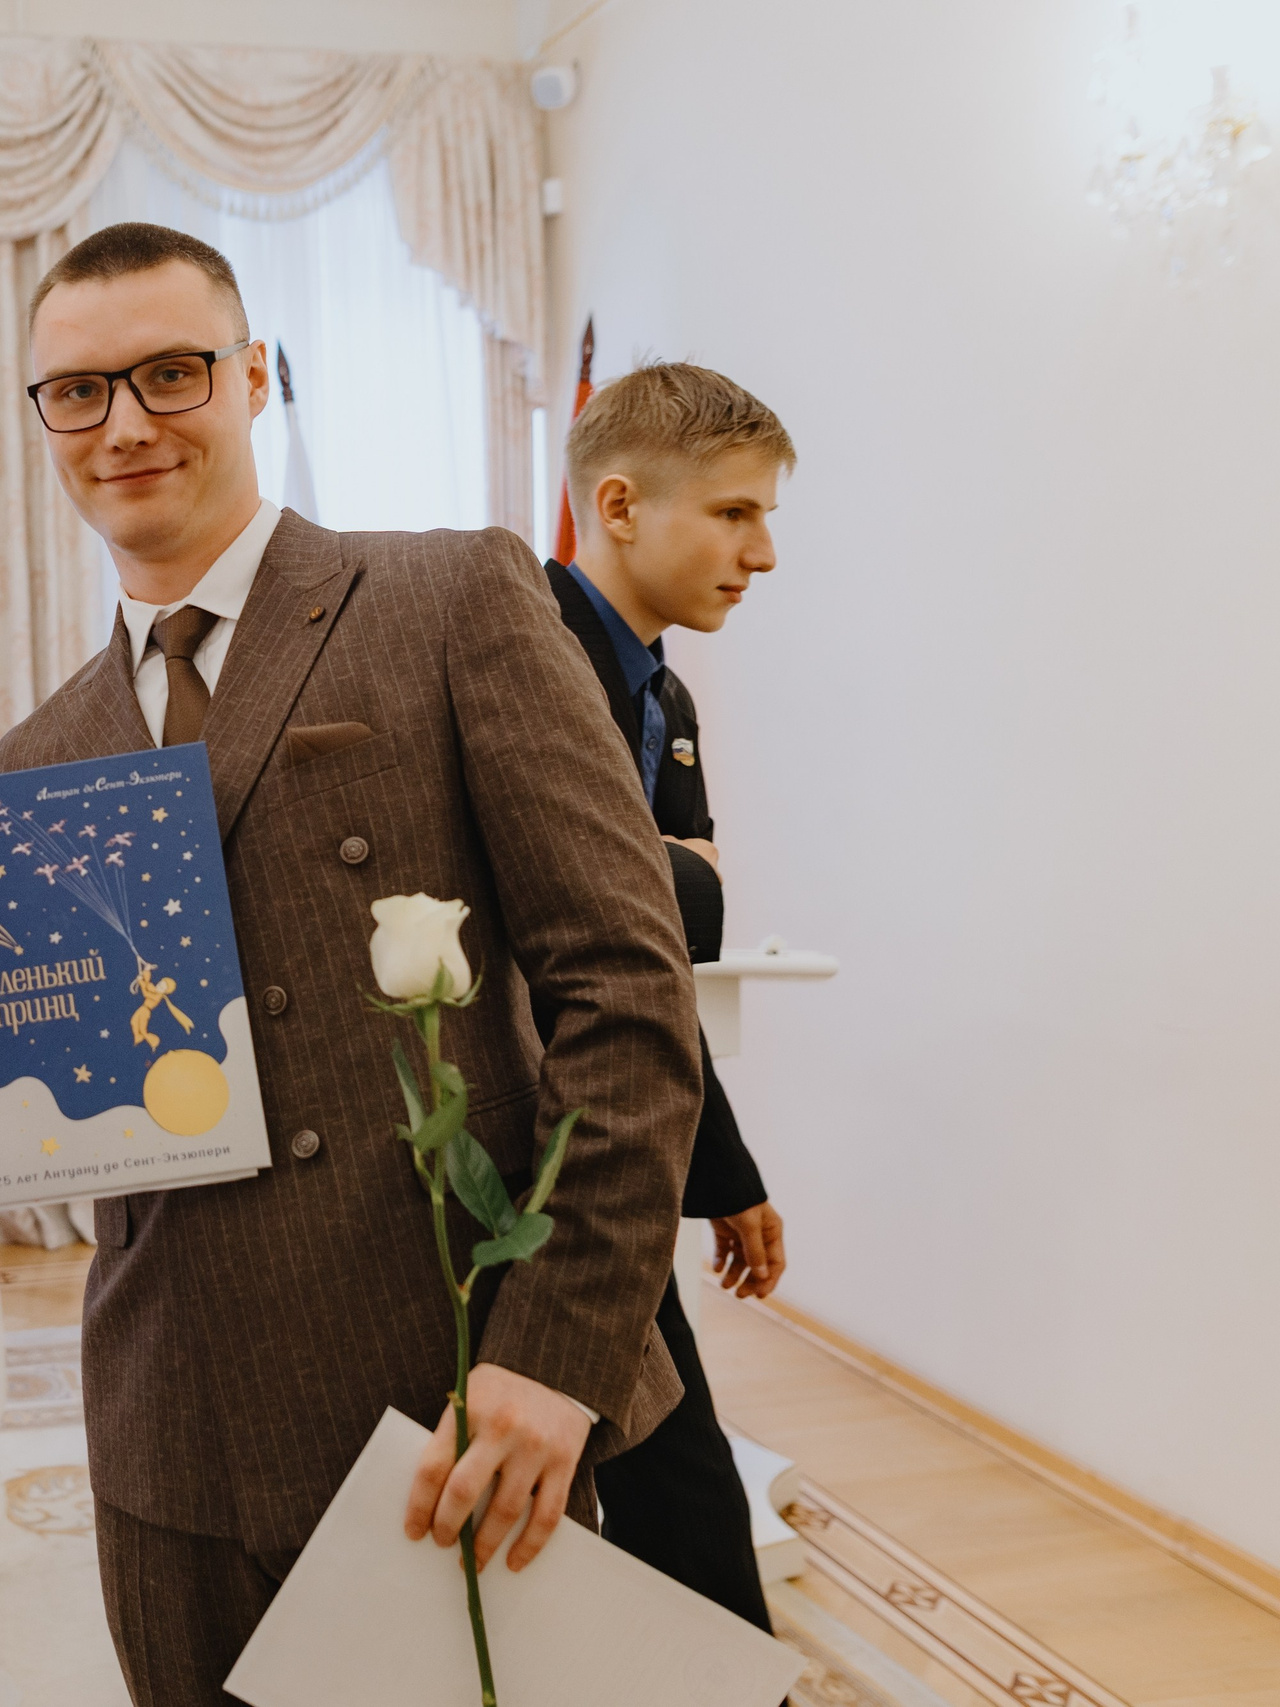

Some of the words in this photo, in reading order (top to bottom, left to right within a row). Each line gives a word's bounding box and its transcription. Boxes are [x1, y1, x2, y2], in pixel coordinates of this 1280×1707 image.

[36, 787, 80, 801] Антуан
[83, 783, 95, 793] де
[95, 770, 182, 791] Сент-Экзюпери
[17, 1173, 38, 1184] лет
[44, 1164, 99, 1180] Антуану
[103, 1161, 119, 1173] де
[124, 1146, 231, 1168] Сент-Экзюпери
